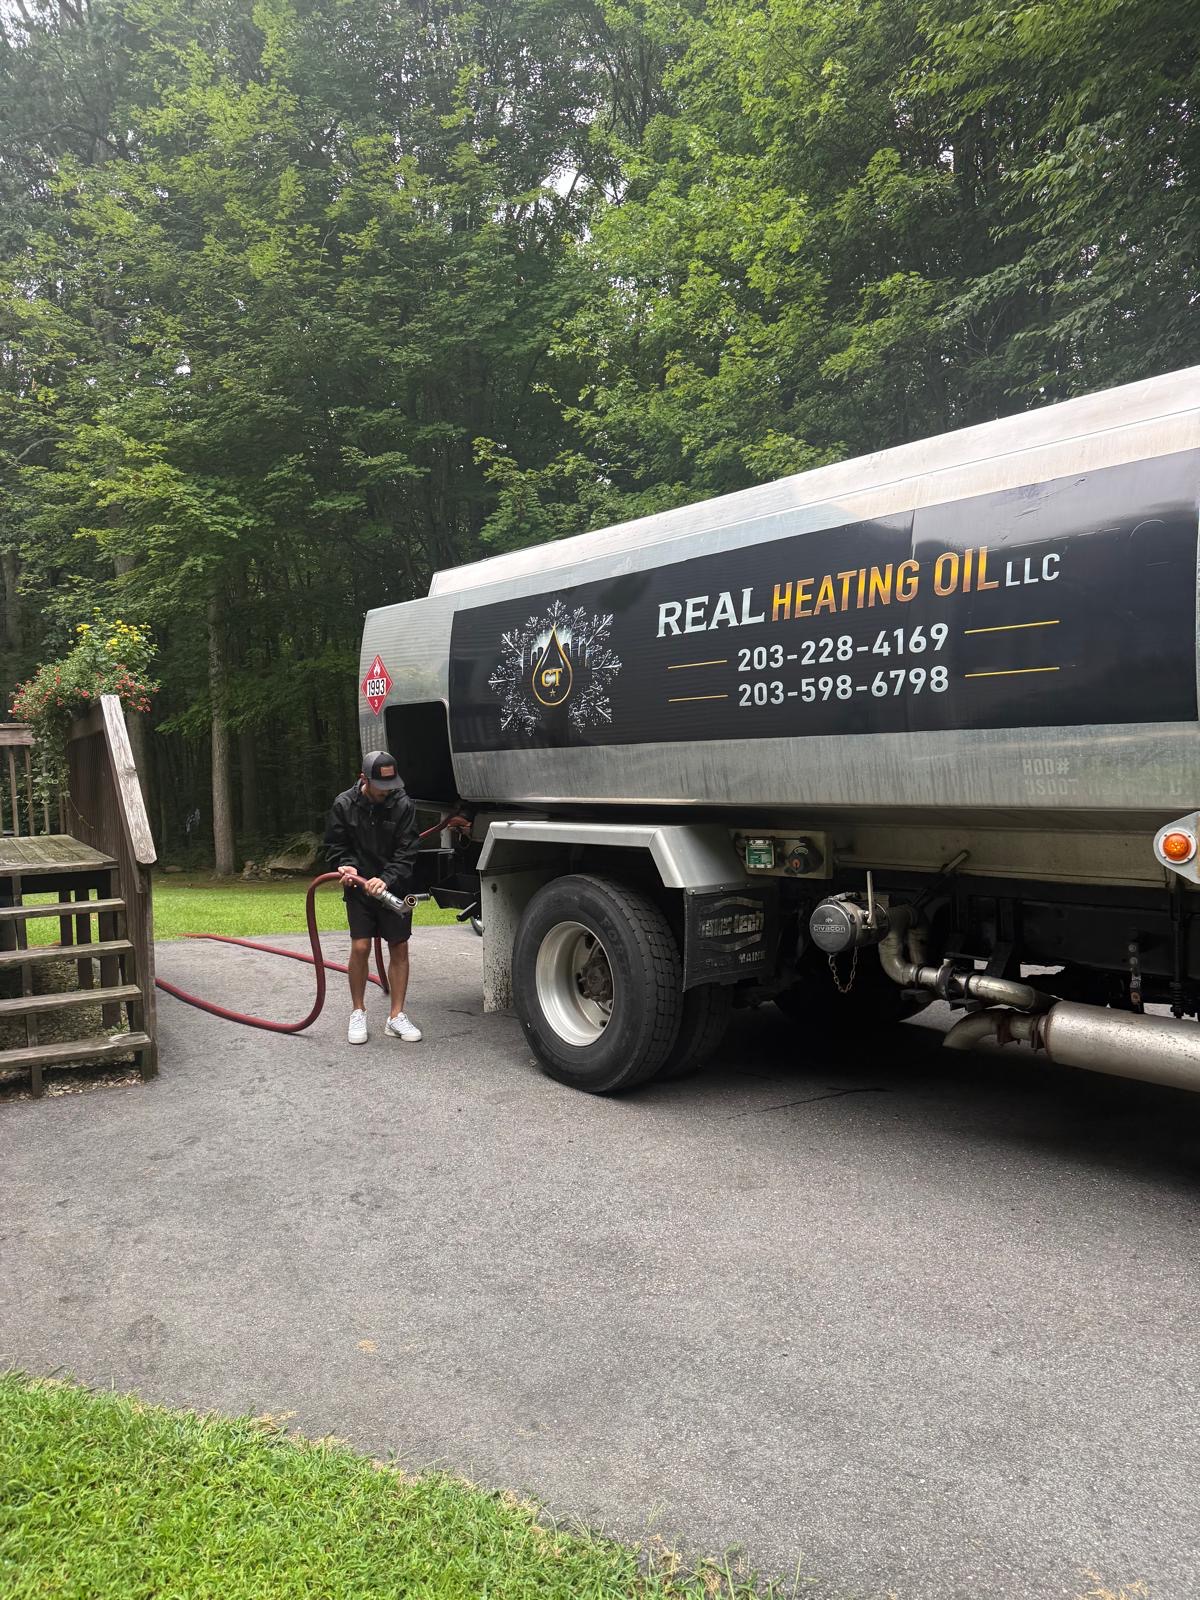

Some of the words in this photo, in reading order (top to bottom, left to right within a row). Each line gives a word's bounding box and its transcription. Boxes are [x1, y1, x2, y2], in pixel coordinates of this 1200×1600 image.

[656, 588, 765, 638] REAL
[771, 559, 920, 622] HEATING
[933, 546, 999, 597] OIL
[1005, 553, 1060, 587] LLC
[738, 622, 949, 672] 203-228-4169
[368, 679, 385, 696] 1993
[738, 665, 949, 707] 203-598-6798
[1022, 758, 1070, 775] HOD#
